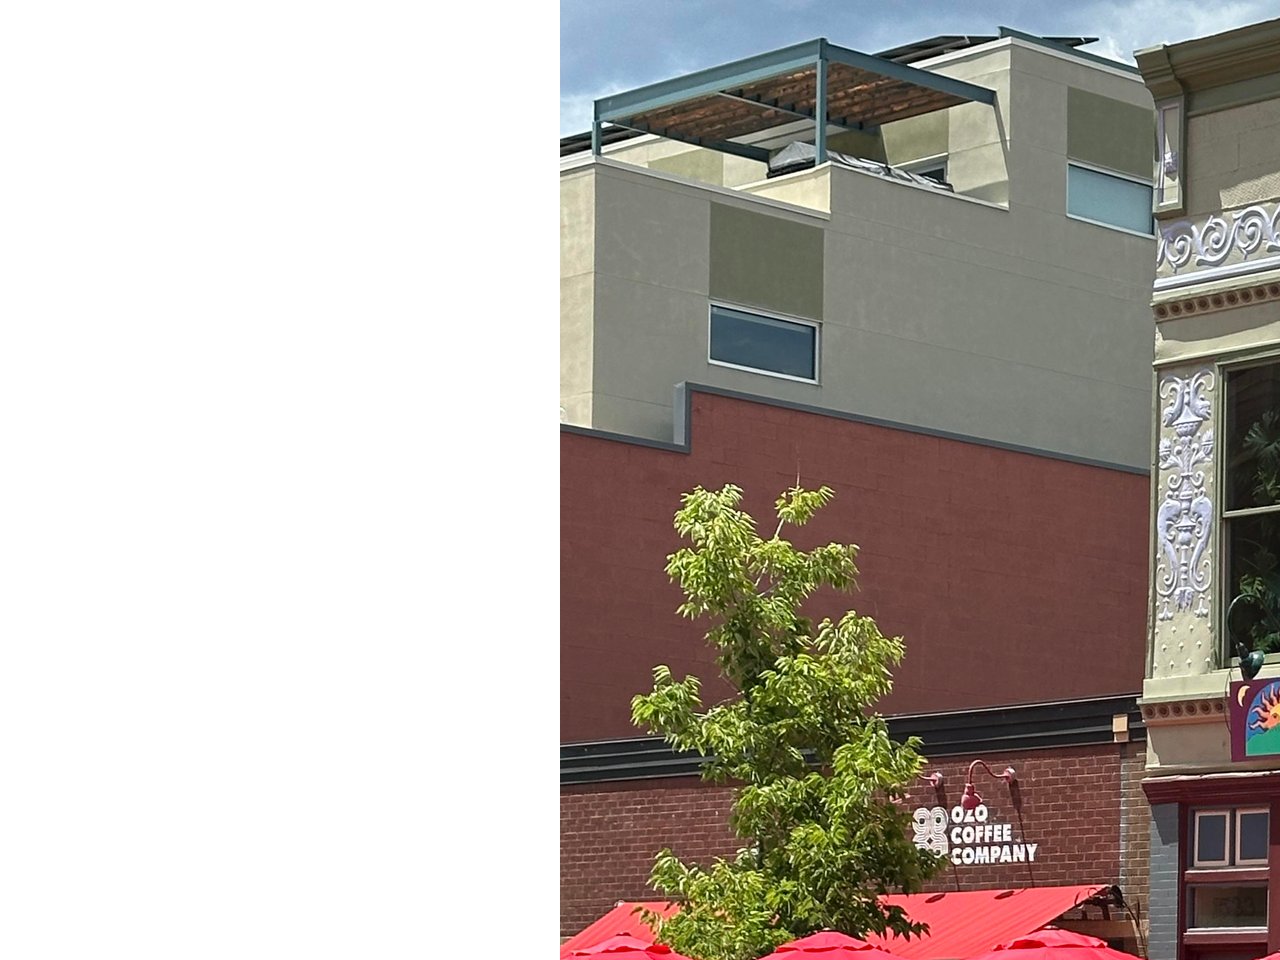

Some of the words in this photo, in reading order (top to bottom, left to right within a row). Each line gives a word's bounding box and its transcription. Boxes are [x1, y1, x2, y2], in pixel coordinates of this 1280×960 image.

[951, 804, 988, 823] OZO
[951, 824, 1012, 844] COFFEE
[951, 843, 1038, 865] COMPANY
